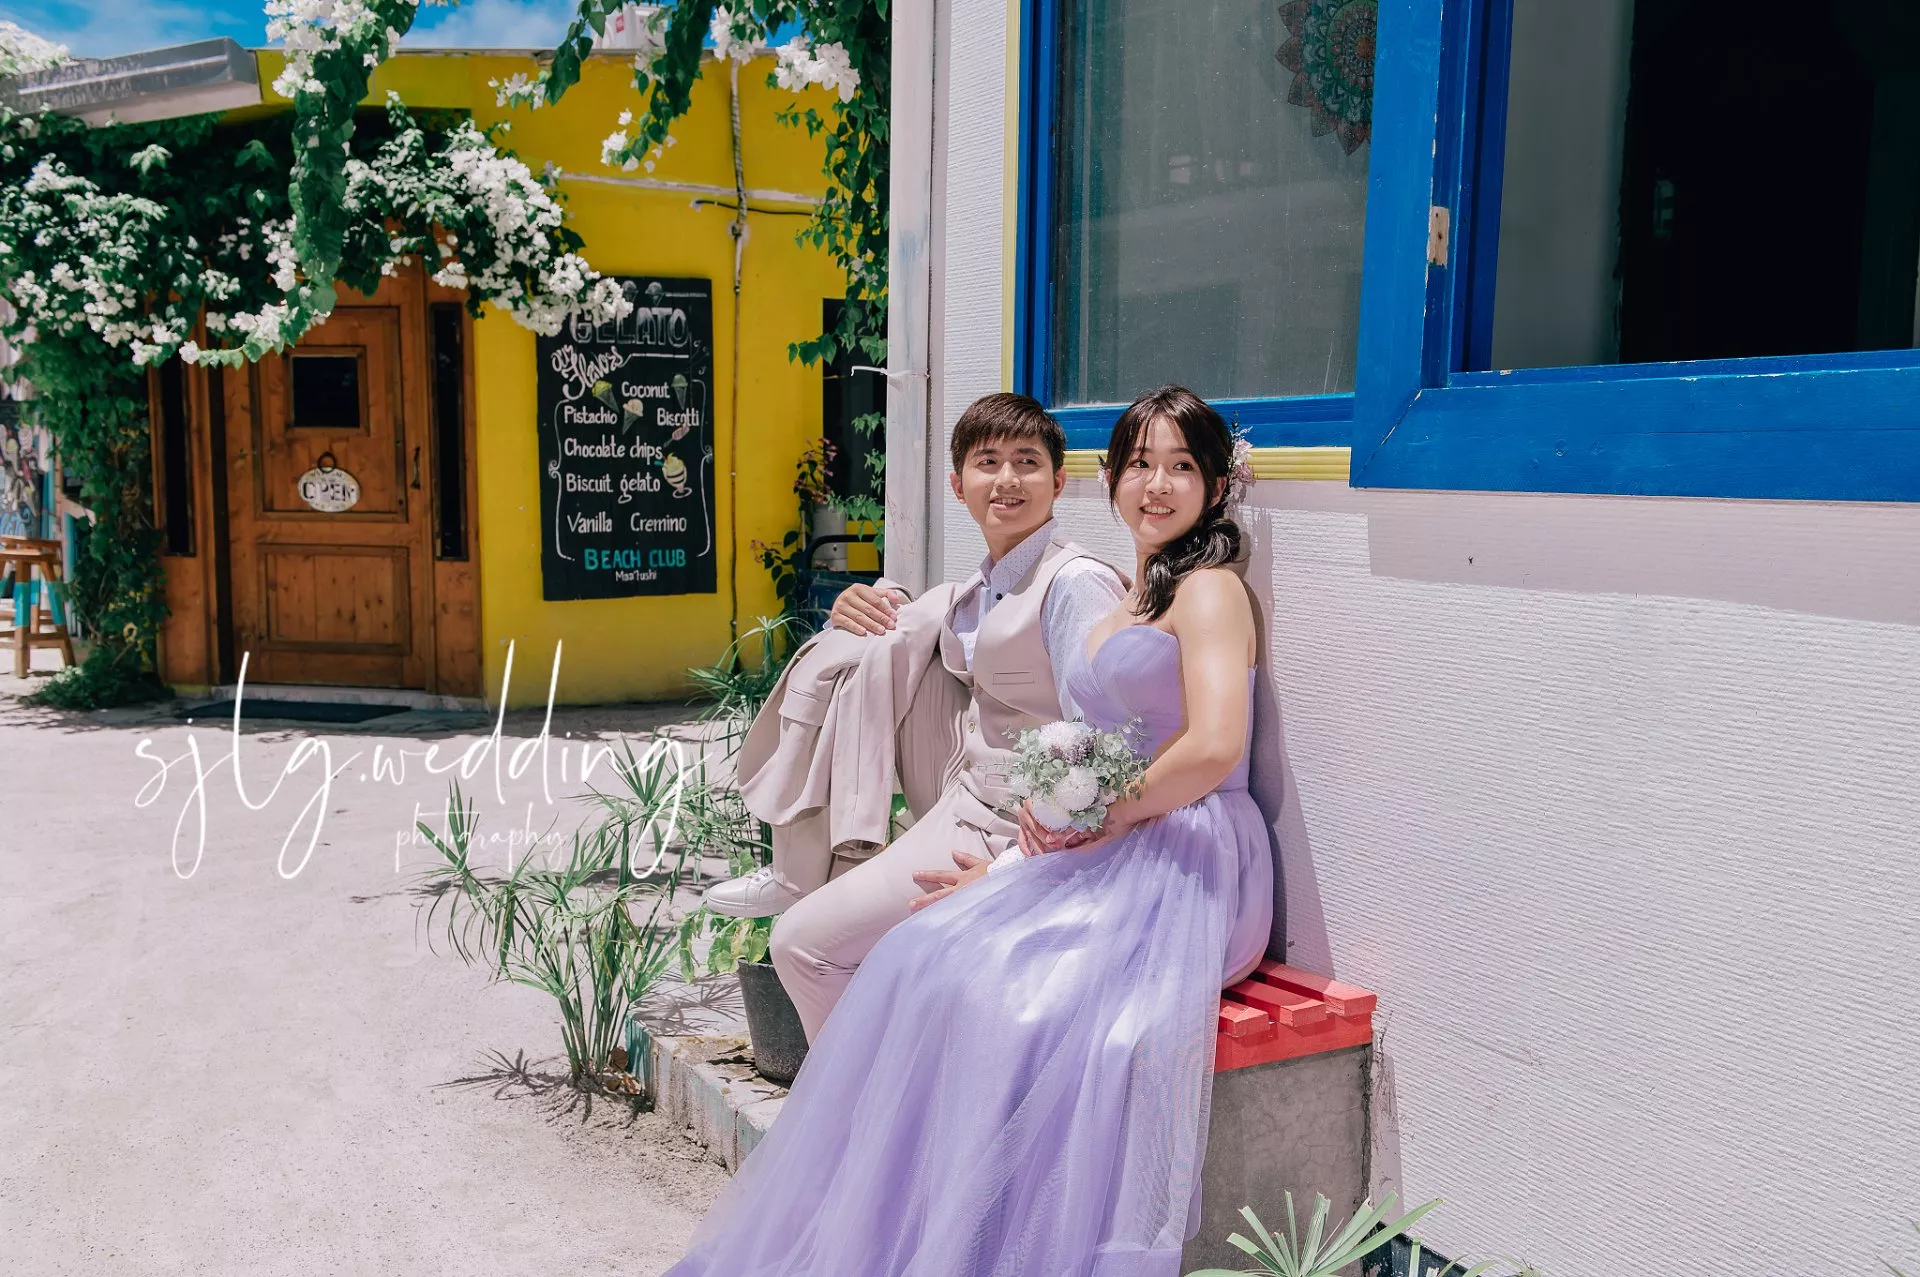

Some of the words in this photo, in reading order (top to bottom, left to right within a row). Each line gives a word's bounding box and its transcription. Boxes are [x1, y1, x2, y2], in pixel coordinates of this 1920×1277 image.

[621, 381, 670, 399] Coconut
[563, 405, 618, 424] Pistachio
[656, 407, 700, 427] Biscotti
[563, 434, 625, 458] Chocolate
[629, 435, 663, 465] chips
[565, 472, 613, 493] Biscuit
[617, 471, 661, 504] gelato
[566, 511, 613, 534] Vanilla
[629, 512, 687, 532] Cremino
[584, 548, 641, 570] BEACH
[648, 548, 687, 567] CLUB
